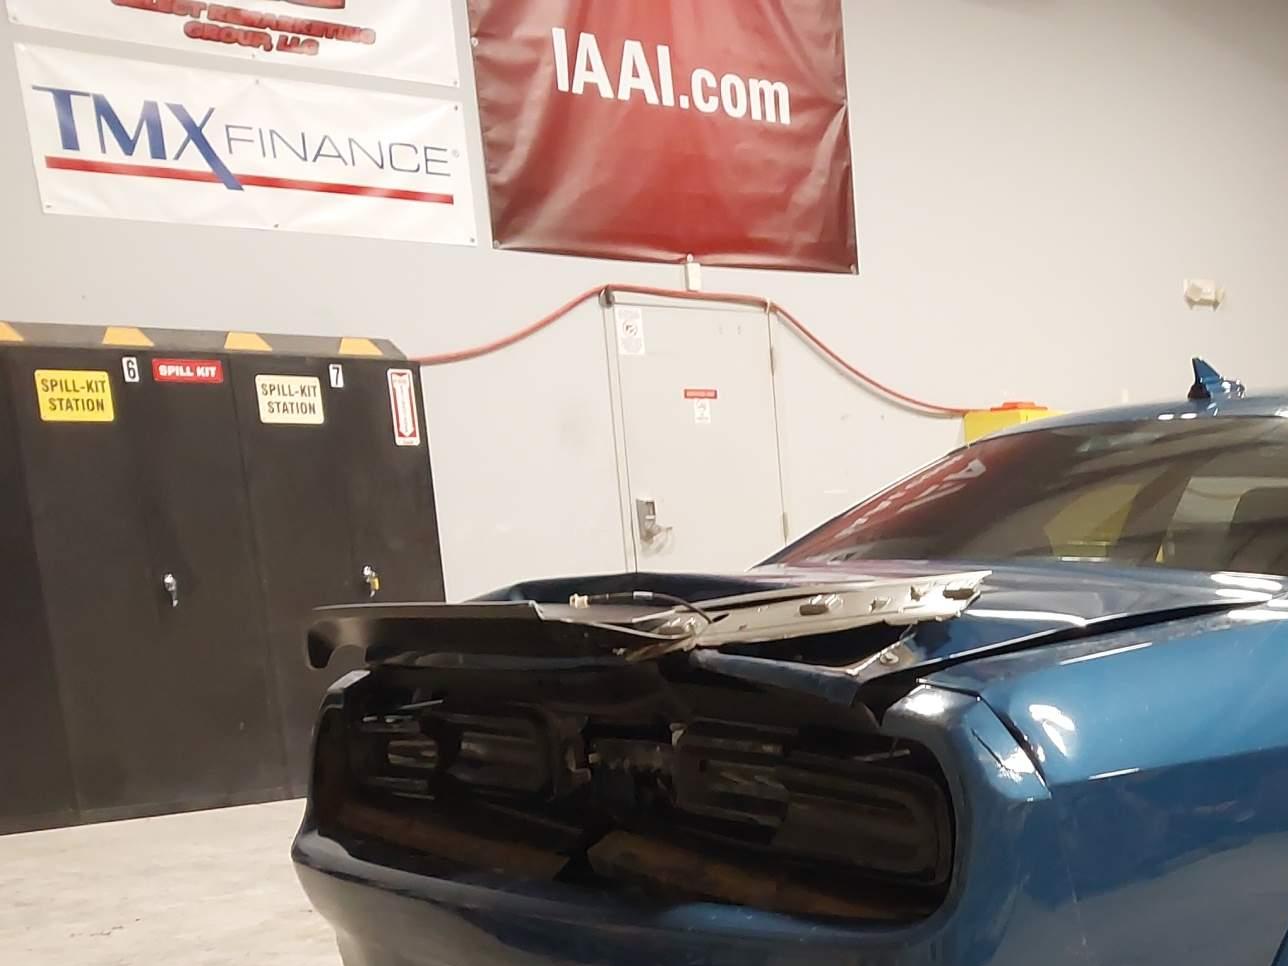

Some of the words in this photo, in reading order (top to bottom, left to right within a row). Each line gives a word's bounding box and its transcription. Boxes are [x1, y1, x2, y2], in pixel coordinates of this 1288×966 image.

[551, 27, 791, 125] IAAI.com
[31, 84, 244, 191] TMX
[224, 124, 451, 177] FINANCE
[126, 359, 136, 379] 6
[158, 365, 195, 377] SPILL
[196, 366, 217, 378] KIT
[332, 366, 340, 386] 7
[40, 378, 107, 393] SPILL-KIT
[261, 383, 317, 398] SPILL-KIT
[48, 397, 105, 412] STATION
[267, 401, 316, 415] STATION
